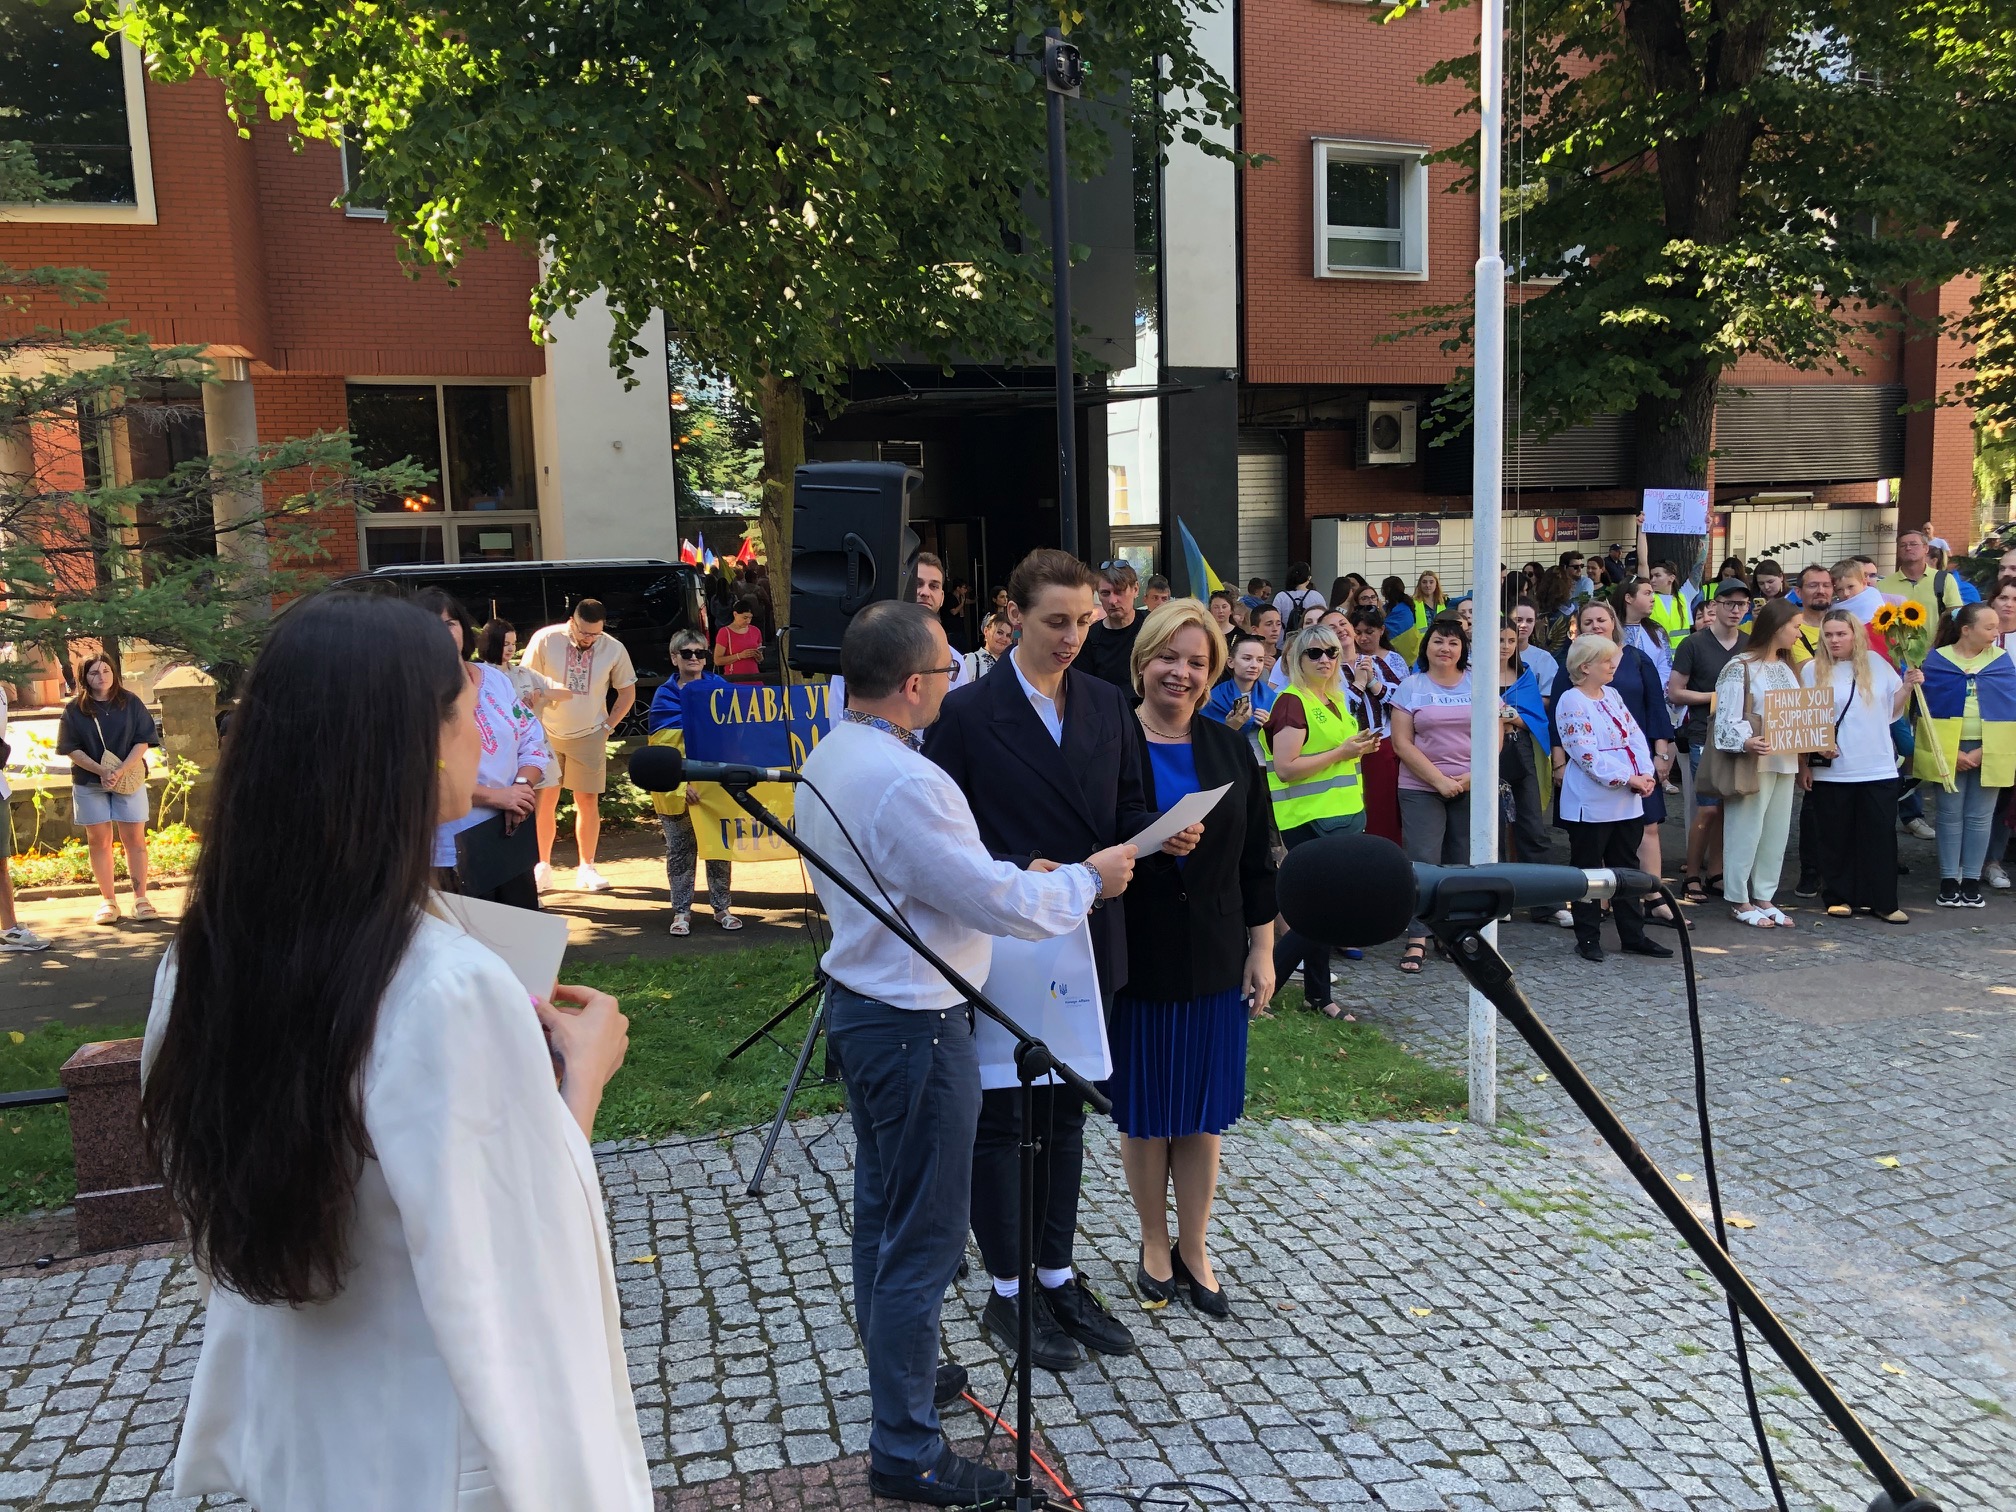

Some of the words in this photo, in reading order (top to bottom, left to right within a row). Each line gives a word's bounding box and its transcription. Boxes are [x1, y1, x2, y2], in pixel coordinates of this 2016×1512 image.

[1392, 525, 1414, 534] allegro
[710, 686, 795, 724] СЛАВА
[1766, 692, 1801, 709] THANK
[1808, 690, 1829, 707] YOU
[1767, 712, 1778, 729] for
[1779, 708, 1833, 728] SUPPORTING
